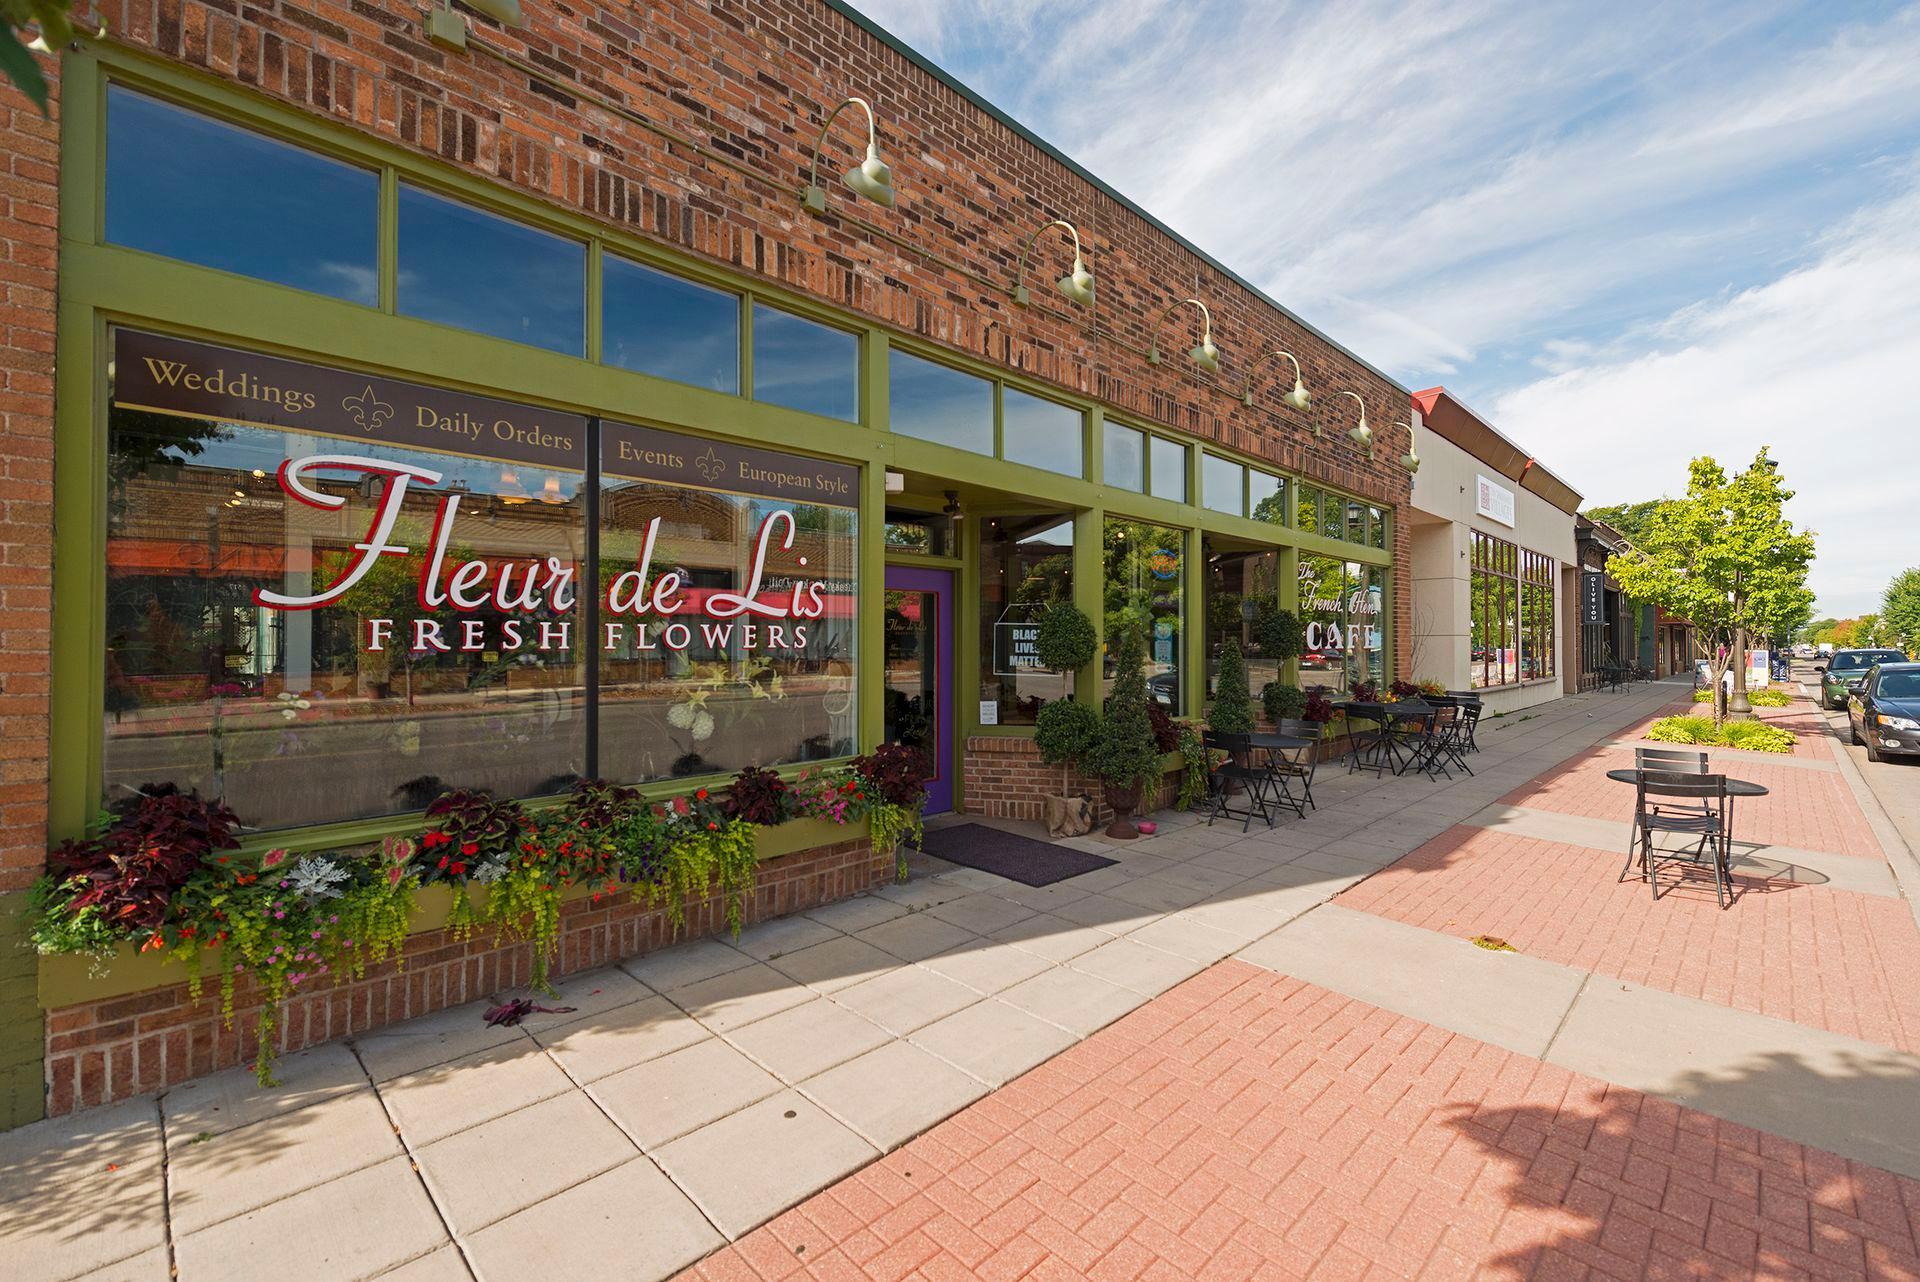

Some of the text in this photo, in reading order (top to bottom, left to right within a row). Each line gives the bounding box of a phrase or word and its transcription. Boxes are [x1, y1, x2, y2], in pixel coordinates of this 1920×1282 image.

[142, 357, 316, 412] Weddings
[415, 406, 573, 452] Daily Orders
[618, 441, 684, 468] Events
[738, 461, 849, 495] European Style
[253, 454, 824, 619] Fleur de Lis
[1298, 560, 1316, 580] The
[1301, 580, 1378, 616] French Hen
[367, 619, 807, 653] FRESH FLOWERS
[1013, 629, 1041, 640] BLAC
[1009, 655, 1046, 667] MATTE
